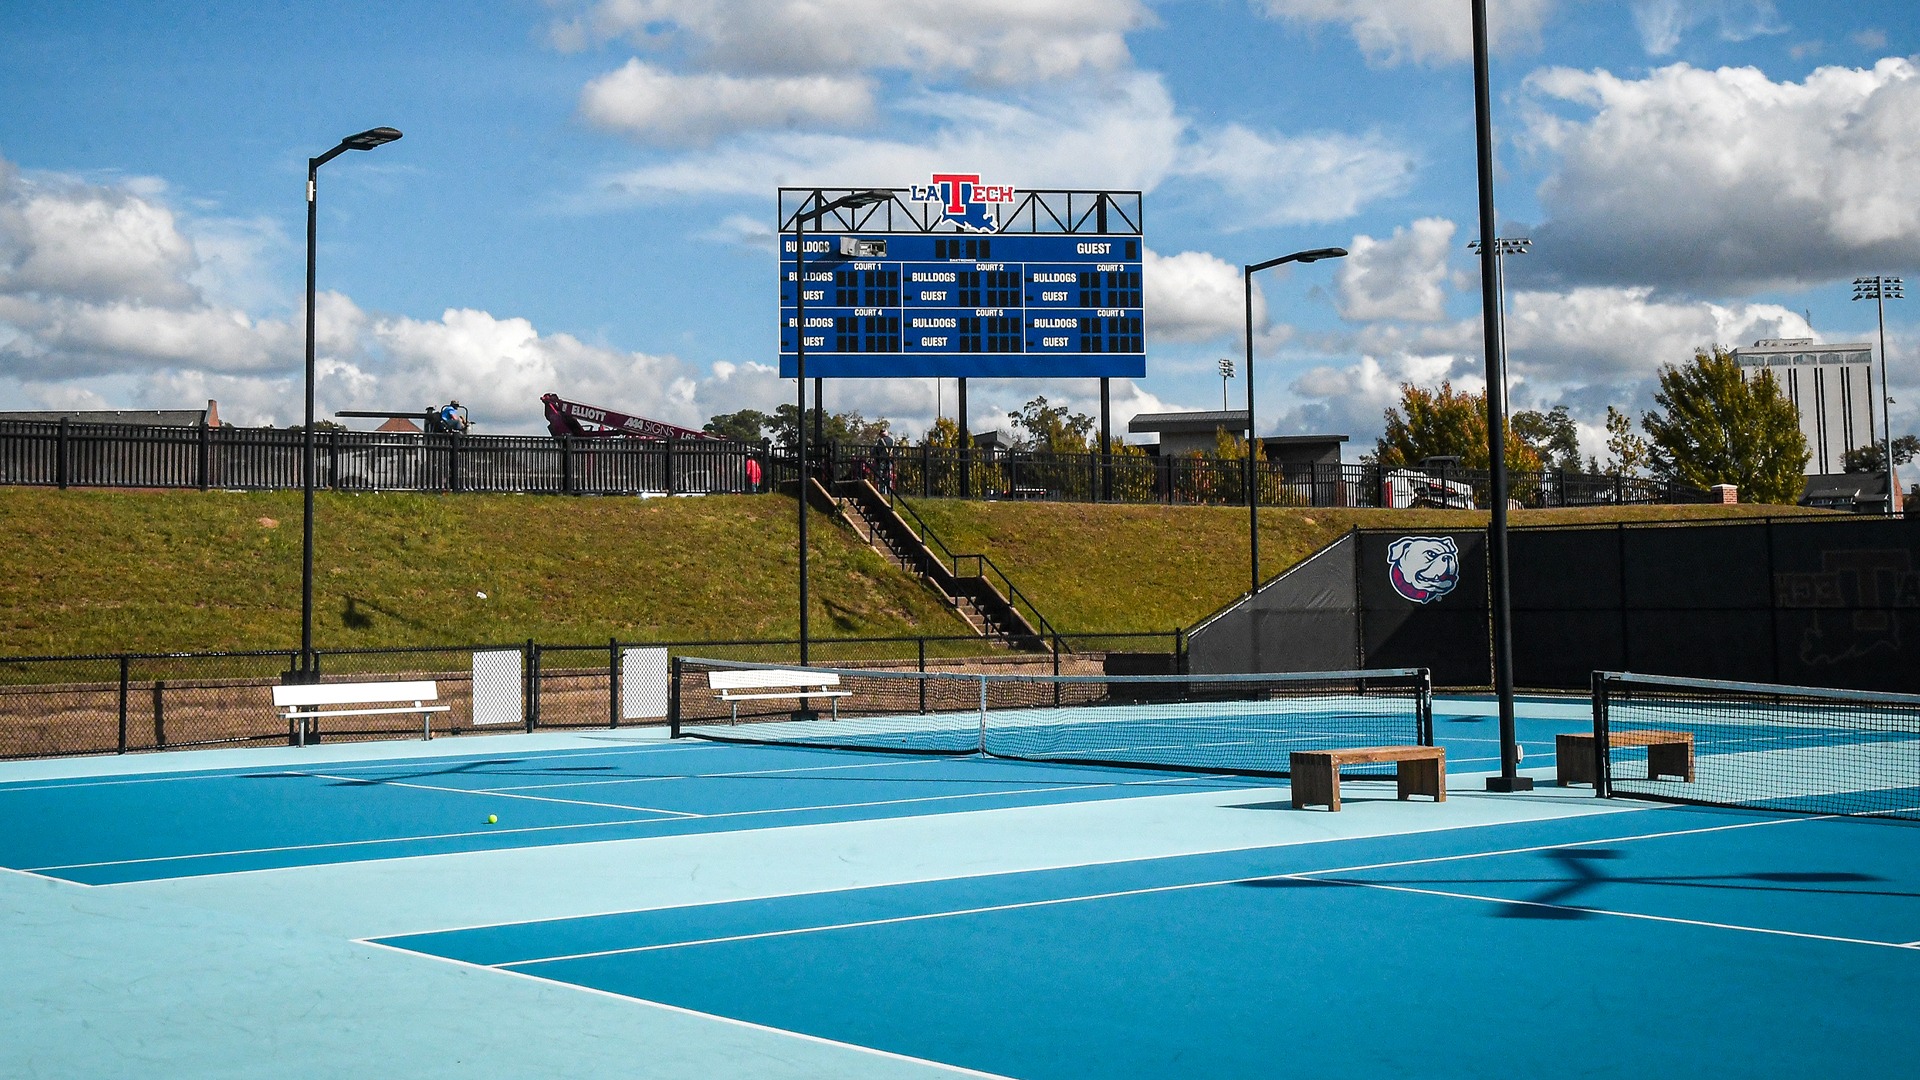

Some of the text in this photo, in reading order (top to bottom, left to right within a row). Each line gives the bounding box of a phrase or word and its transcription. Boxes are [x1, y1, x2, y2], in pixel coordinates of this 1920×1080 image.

[910, 185, 940, 202] LA
[785, 240, 830, 253] BULDOGS
[1076, 242, 1112, 255] GUEST
[854, 263, 876, 271] COURT
[976, 263, 998, 271] COURT
[1097, 264, 1117, 272] COURT
[788, 271, 834, 282] BULDOGS
[911, 272, 956, 283] BULLDOGS
[1033, 273, 1077, 283] BULLDOGS
[803, 290, 825, 301] UEST
[920, 291, 947, 301] GUEST
[1042, 291, 1068, 302] GUEST
[854, 308, 883, 317] COURT 4
[976, 308, 1004, 317] COURT 5
[1097, 309, 1118, 317] COURT
[788, 317, 834, 328] BULDOGS
[912, 318, 957, 328] BULLDOGS
[1033, 318, 1078, 329] BULLDOGS
[803, 336, 825, 347] UEST
[921, 337, 948, 347] GUEST
[1042, 337, 1069, 347] GUEST
[571, 405, 607, 422] ELLIOTT
[643, 421, 676, 437] SIGNS
